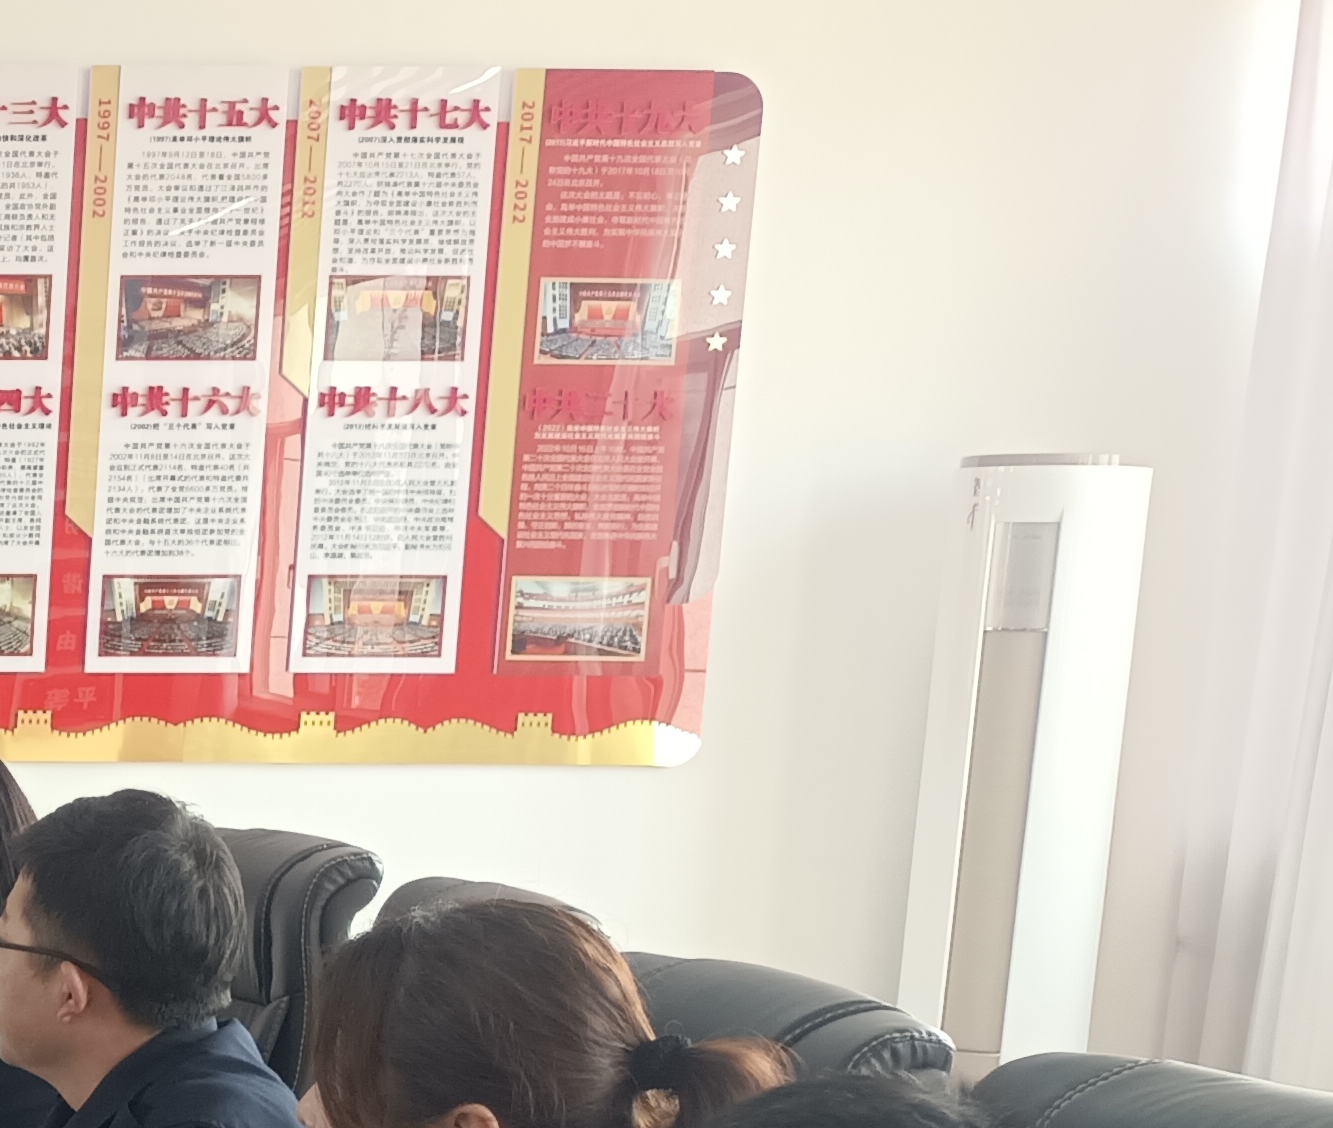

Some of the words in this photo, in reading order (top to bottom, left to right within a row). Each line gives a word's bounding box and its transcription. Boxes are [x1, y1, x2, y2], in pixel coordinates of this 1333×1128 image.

[128, 97, 280, 129] 中共十五大
[339, 98, 491, 130] 中共十七大
[550, 100, 703, 135] 中共十九大
[111, 386, 262, 417] 中共十六大
[318, 386, 470, 417] 中共十八大
